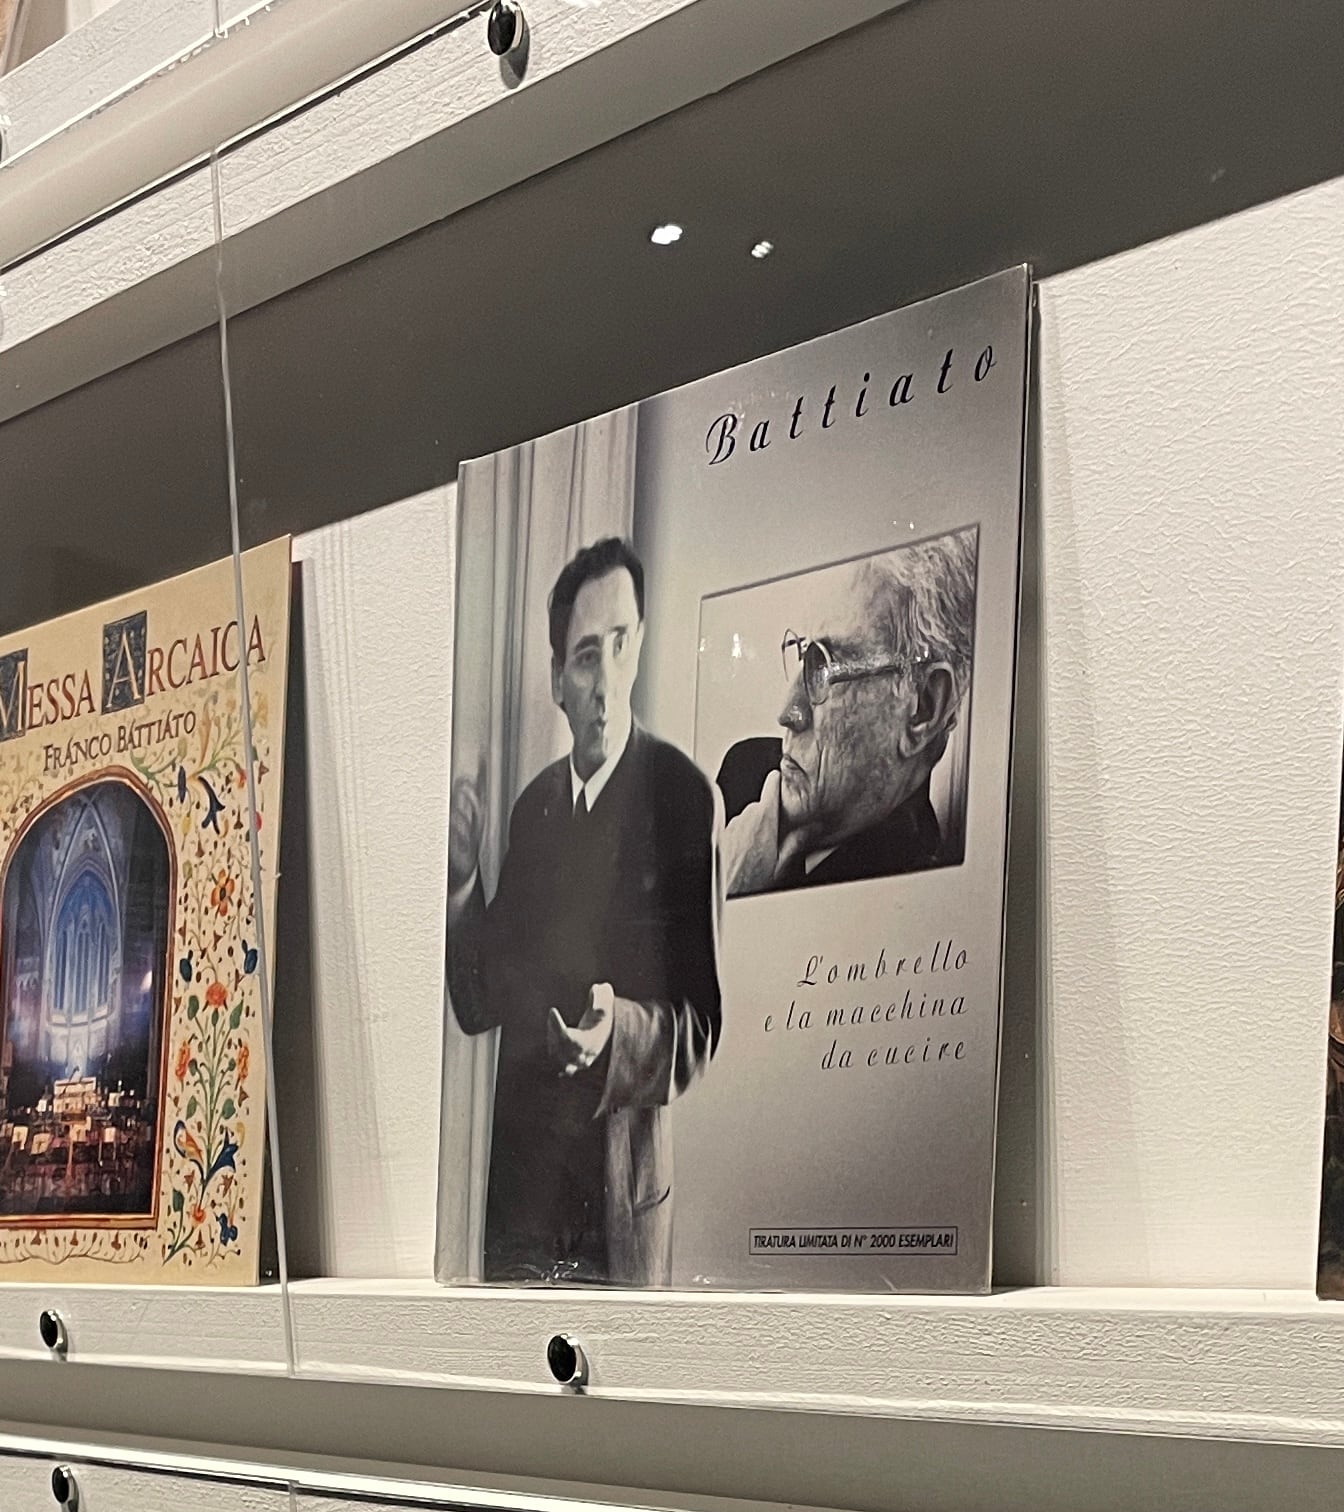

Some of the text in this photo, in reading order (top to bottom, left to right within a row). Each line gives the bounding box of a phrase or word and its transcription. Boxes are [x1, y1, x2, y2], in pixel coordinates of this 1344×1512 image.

[706, 344, 998, 466] Battiato
[796, 939, 969, 987] L'ombrello
[764, 989, 969, 1033] e la macchina
[821, 1037, 967, 1071] da cucire
[753, 1235, 797, 1249] TIRATURA
[798, 1235, 839, 1248] LIMITATA
[841, 1234, 851, 1248] DI
[870, 1234, 896, 1248] 2000
[898, 1233, 954, 1248] ESEMPLARI
